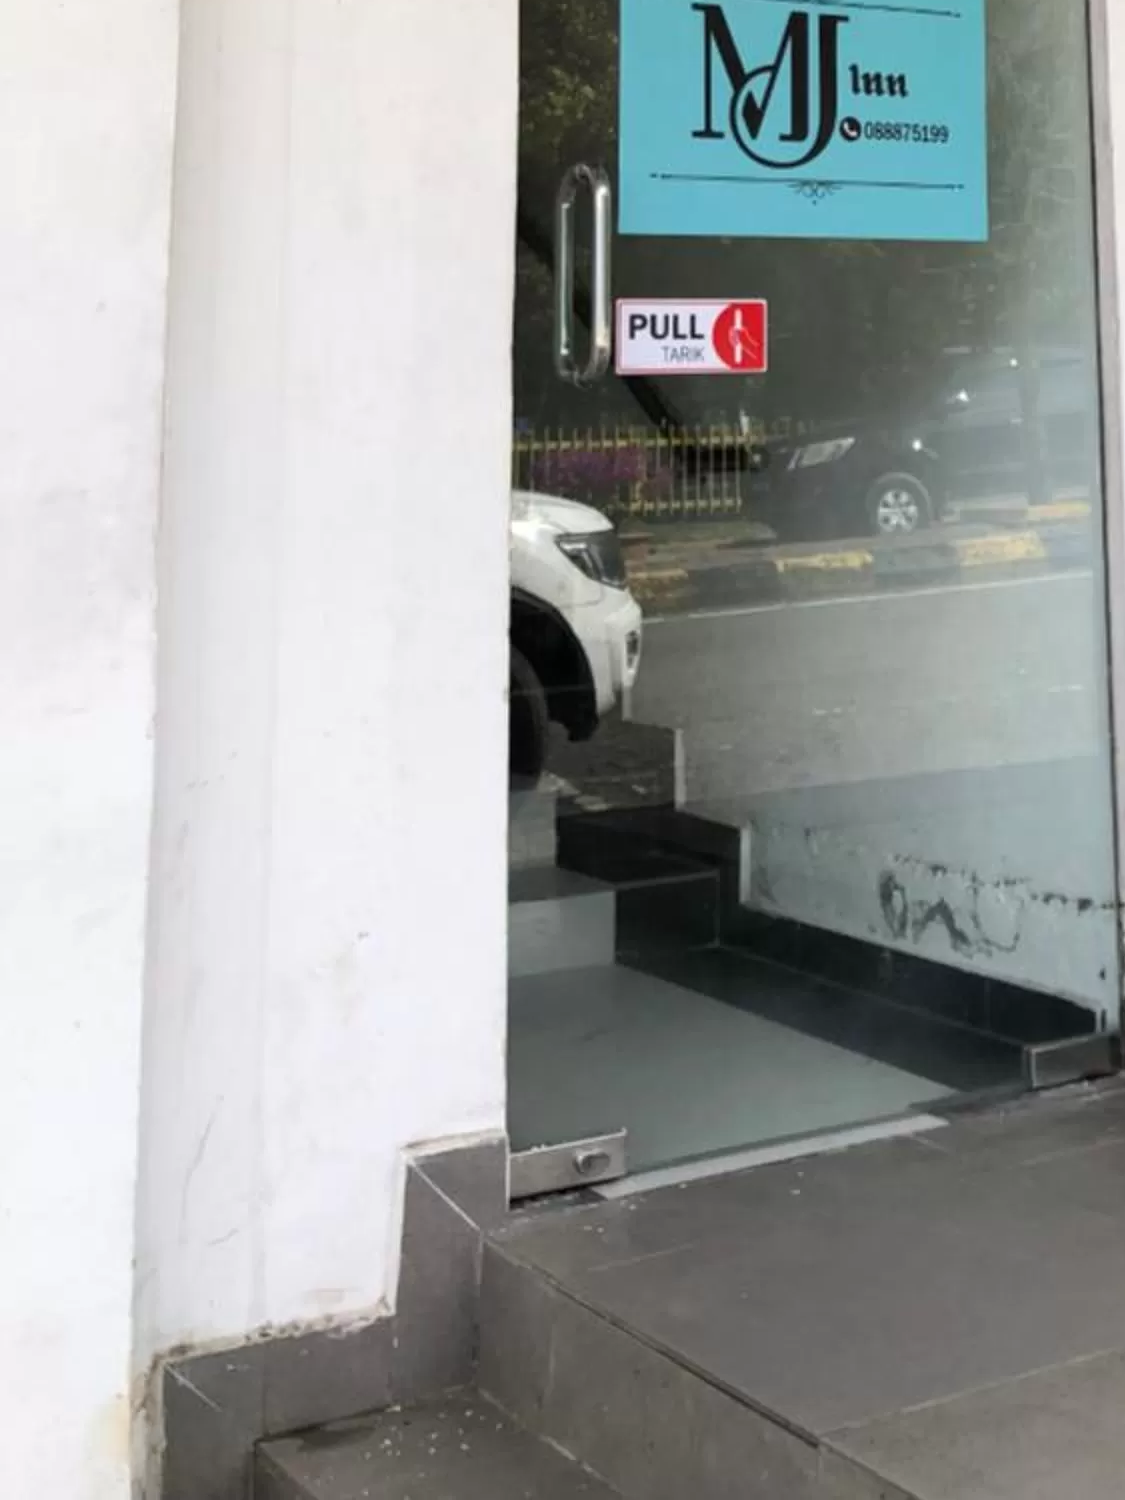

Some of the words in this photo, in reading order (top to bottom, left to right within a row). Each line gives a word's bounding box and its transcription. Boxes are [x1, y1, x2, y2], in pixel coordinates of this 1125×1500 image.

[691, 2, 850, 169] MJ
[848, 63, 909, 98] Inn
[863, 121, 949, 144] 088875199
[629, 313, 705, 340] PULL
[661, 345, 705, 363] TARIK
